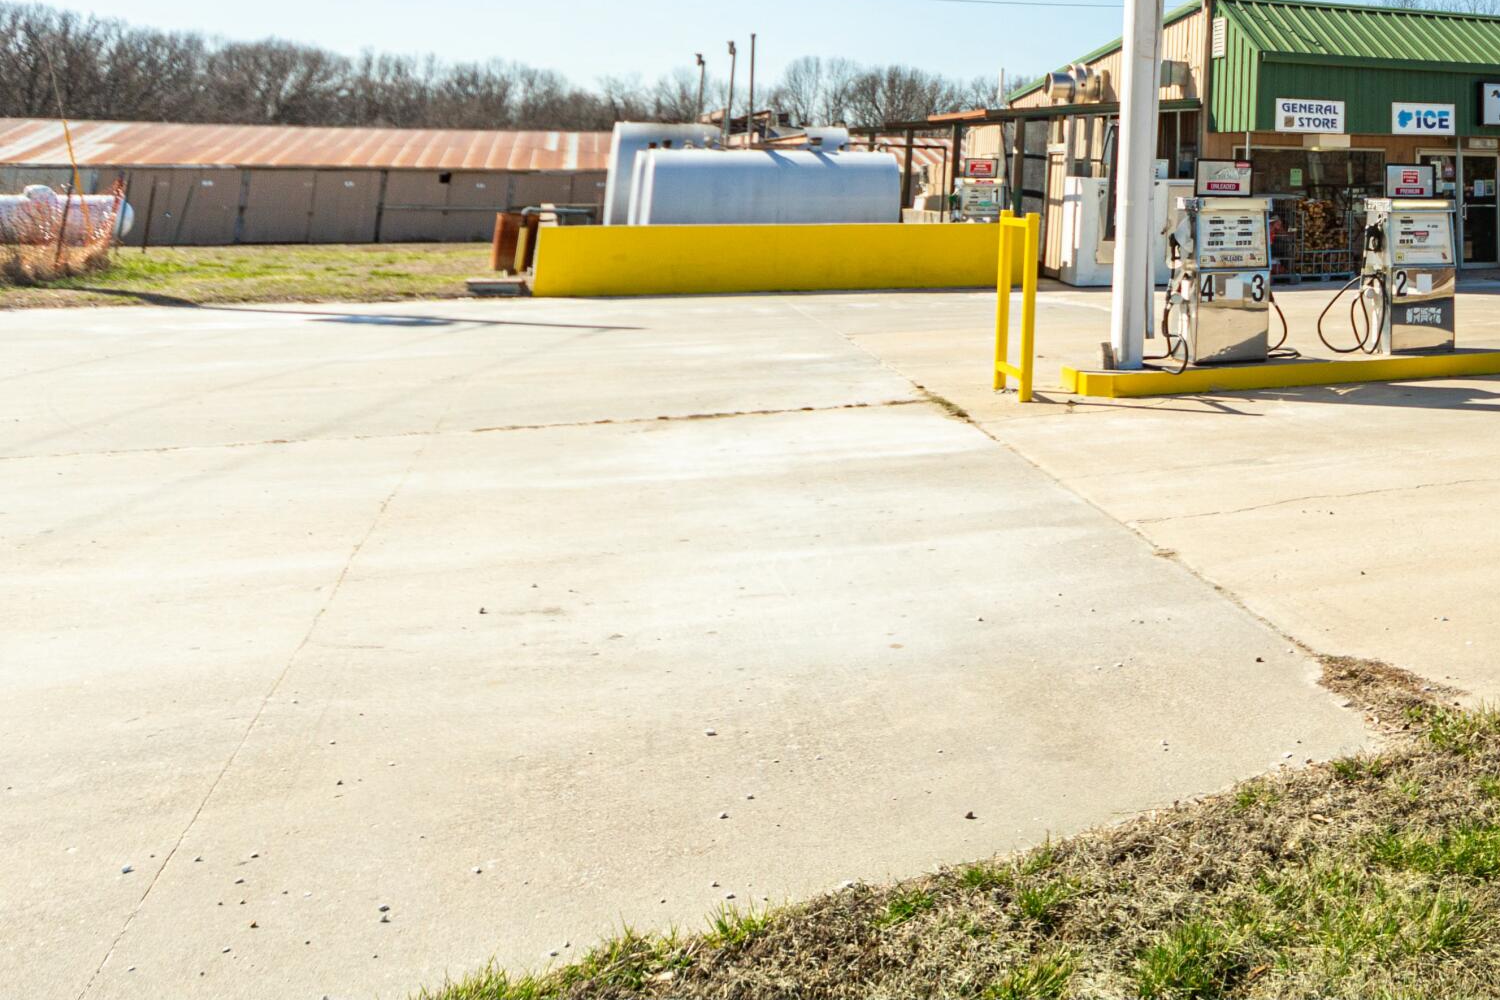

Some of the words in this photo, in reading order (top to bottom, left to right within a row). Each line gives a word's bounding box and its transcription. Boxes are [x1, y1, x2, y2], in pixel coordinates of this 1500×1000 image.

[1282, 103, 1339, 115] GENERAL
[1298, 116, 1338, 129] STORE
[1201, 275, 1215, 302] 4
[1252, 274, 1264, 302] 3
[1396, 271, 1407, 297] 2
